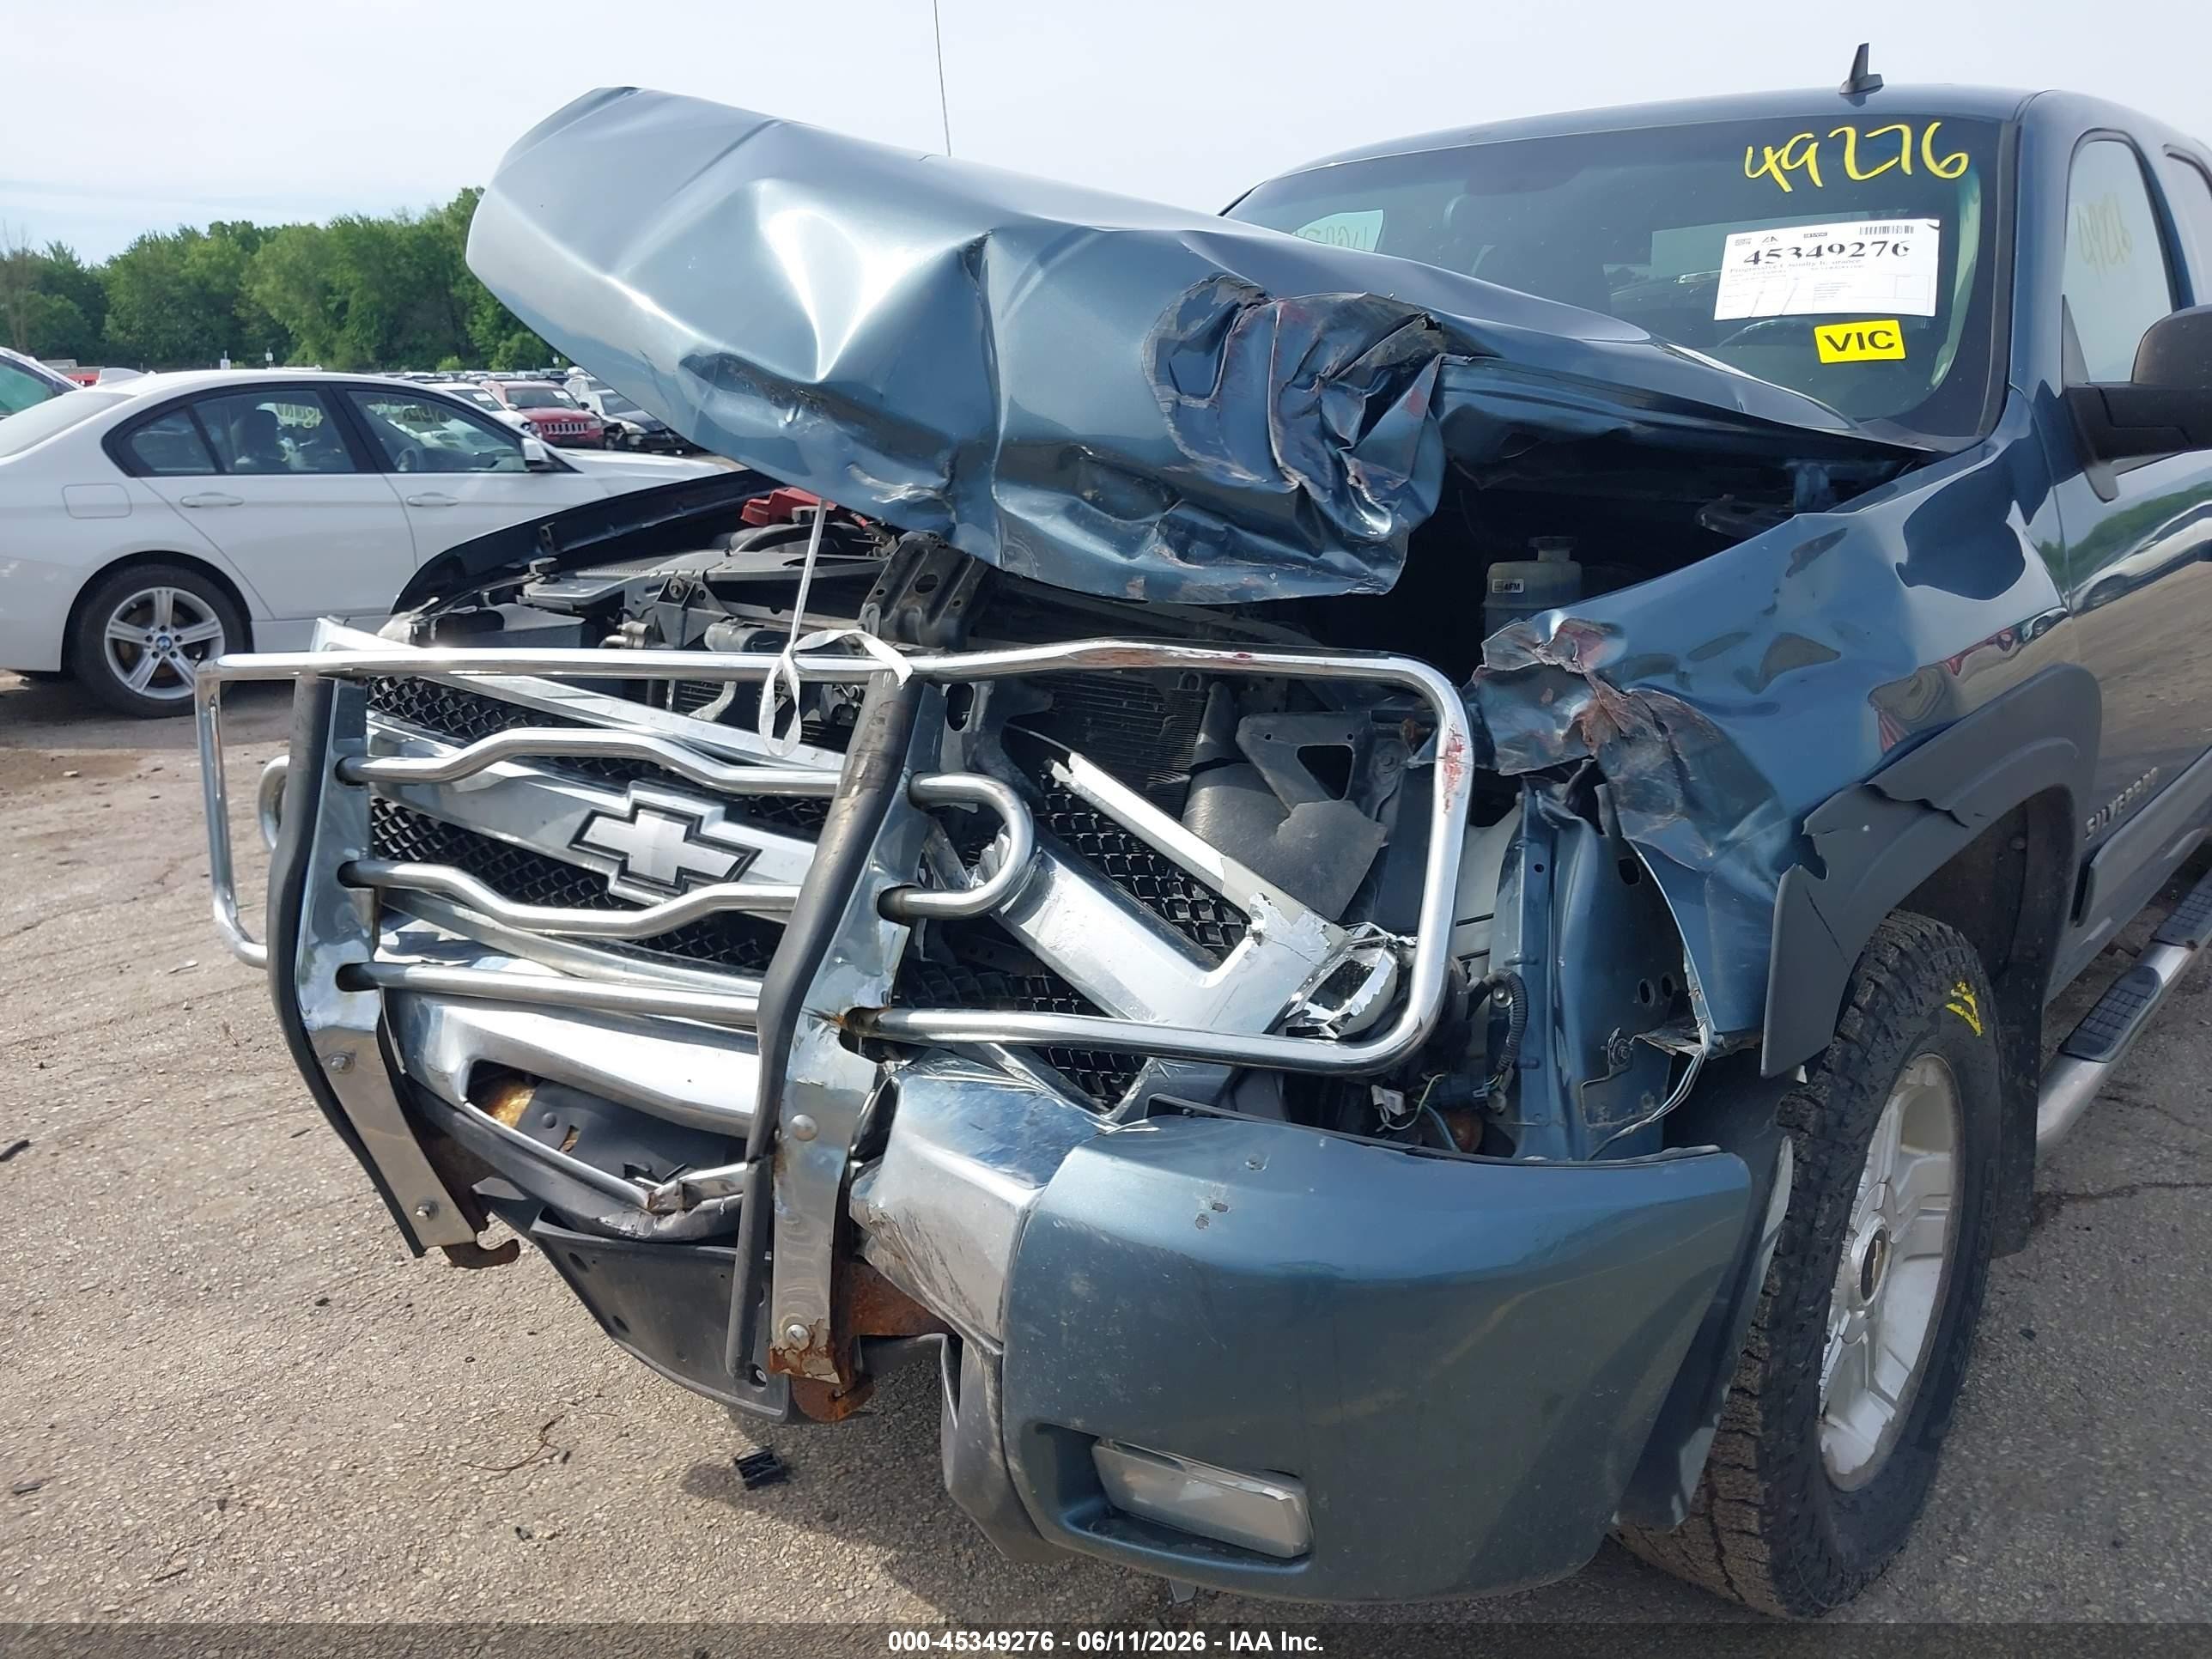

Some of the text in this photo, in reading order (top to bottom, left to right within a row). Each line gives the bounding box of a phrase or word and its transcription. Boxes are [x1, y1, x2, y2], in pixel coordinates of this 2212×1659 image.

[1744, 121, 1969, 192] 49276
[1742, 240, 1911, 265] 45349276
[1823, 330, 1895, 352] VIC
